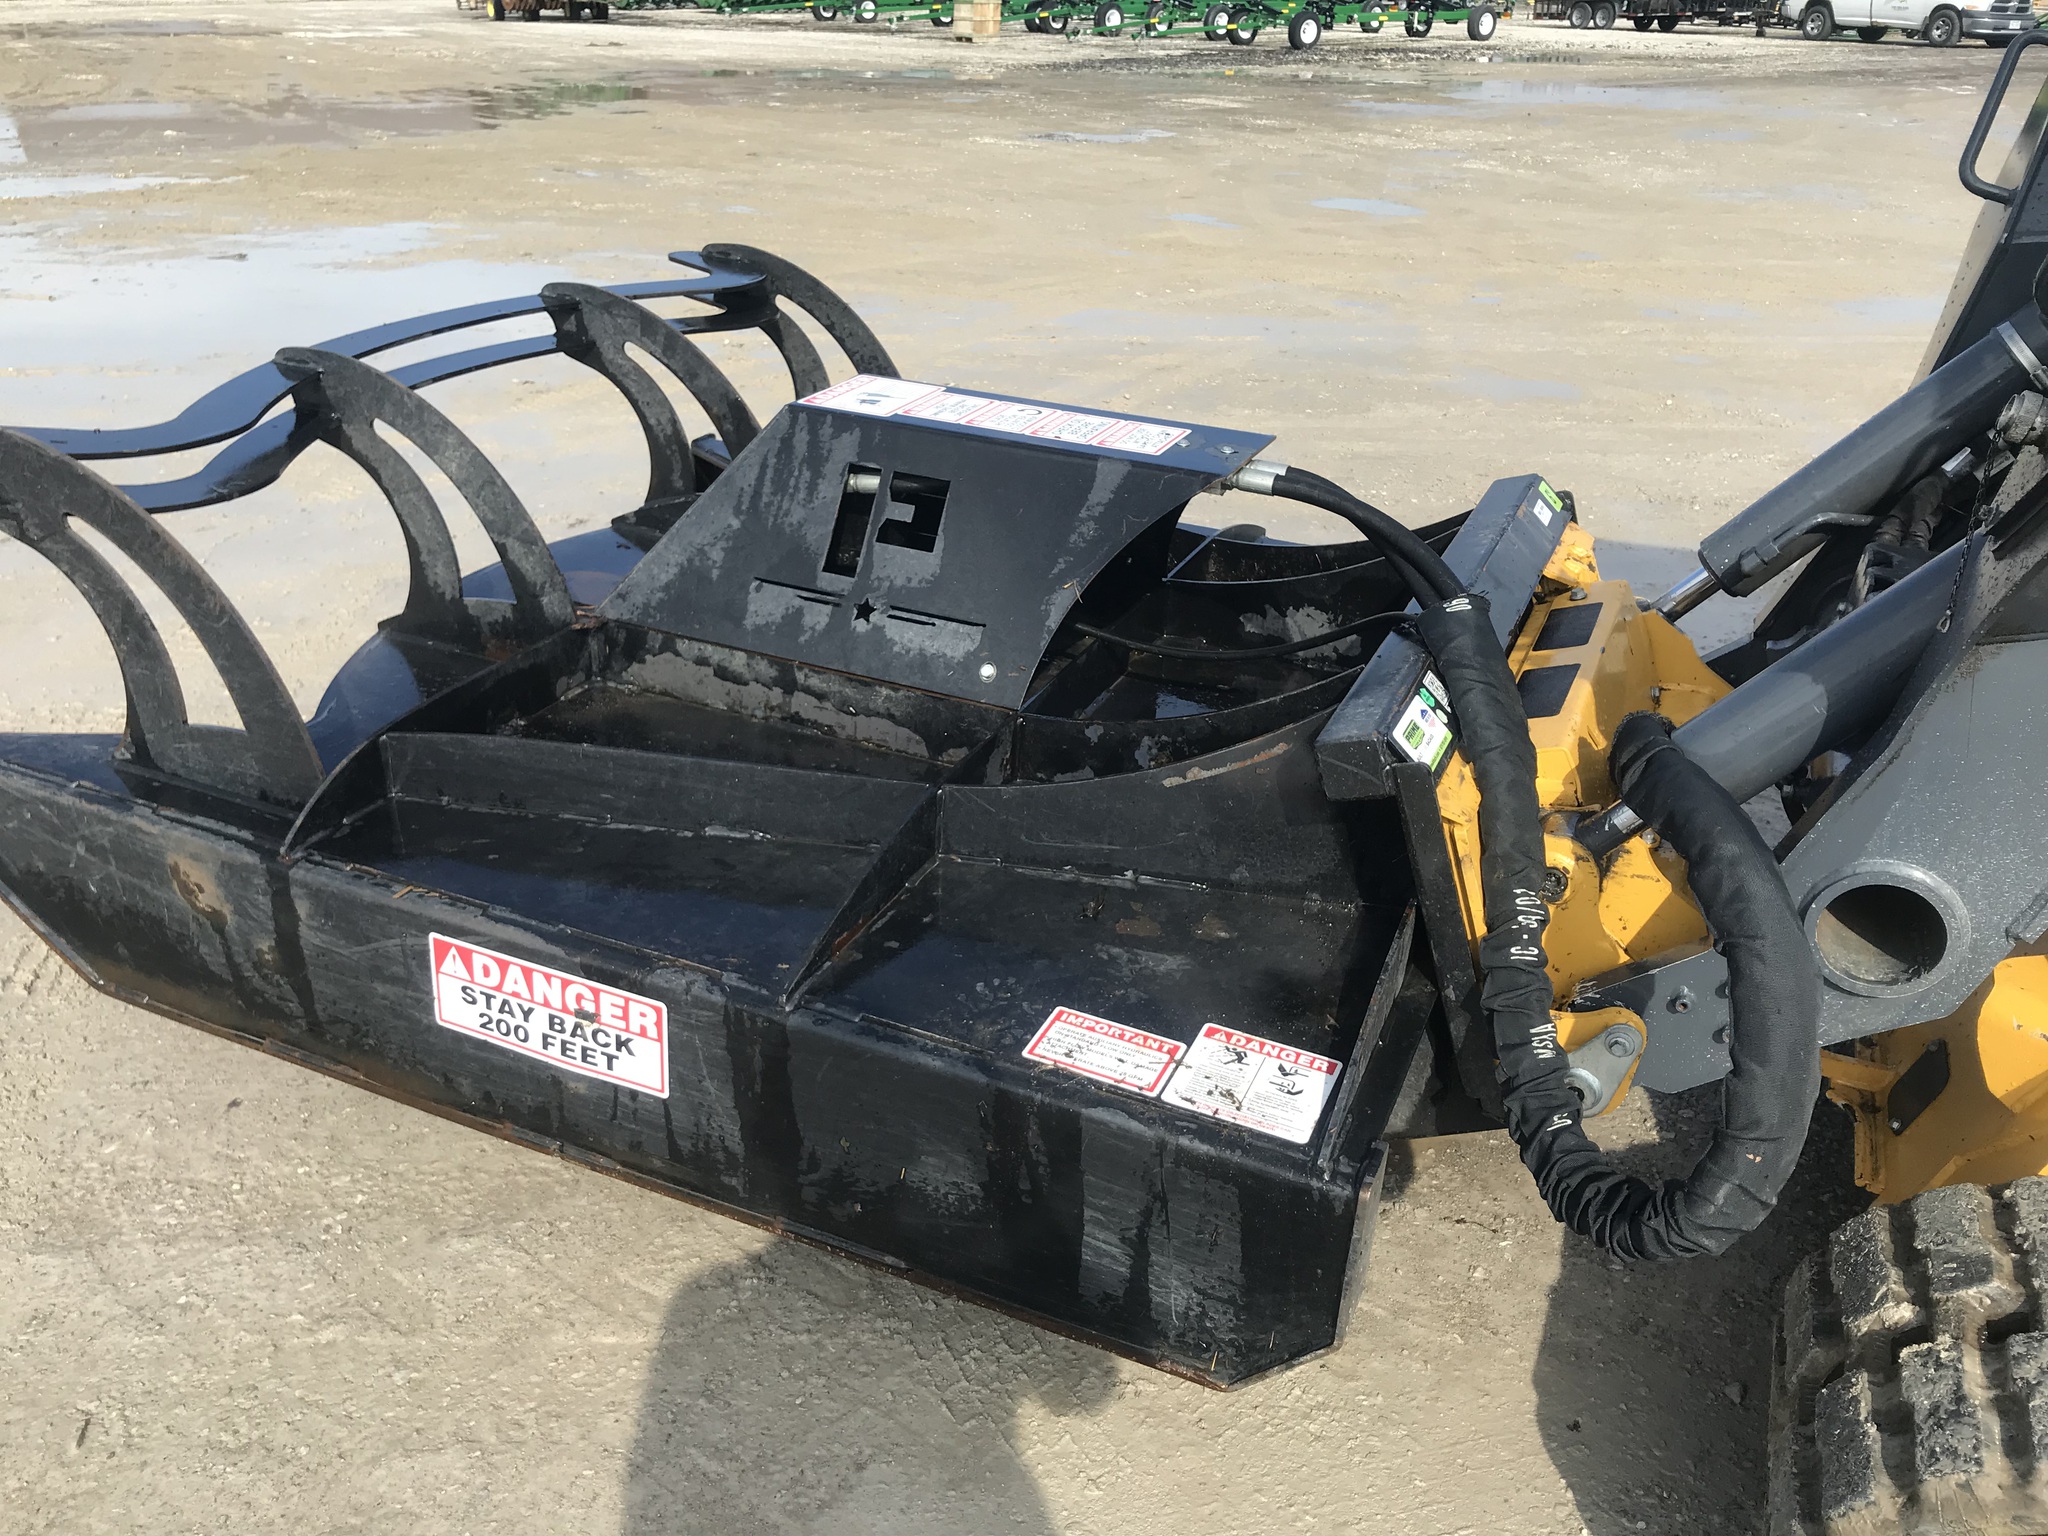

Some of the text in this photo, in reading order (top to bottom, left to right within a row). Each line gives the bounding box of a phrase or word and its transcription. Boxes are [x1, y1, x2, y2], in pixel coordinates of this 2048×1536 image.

[461, 985, 636, 1057] STAY BACK
[472, 951, 659, 1040] DANGER
[478, 1012, 620, 1072] 200 FEET
[1058, 1011, 1174, 1054] IMPORTANT
[1228, 1034, 1330, 1072] DANGER
